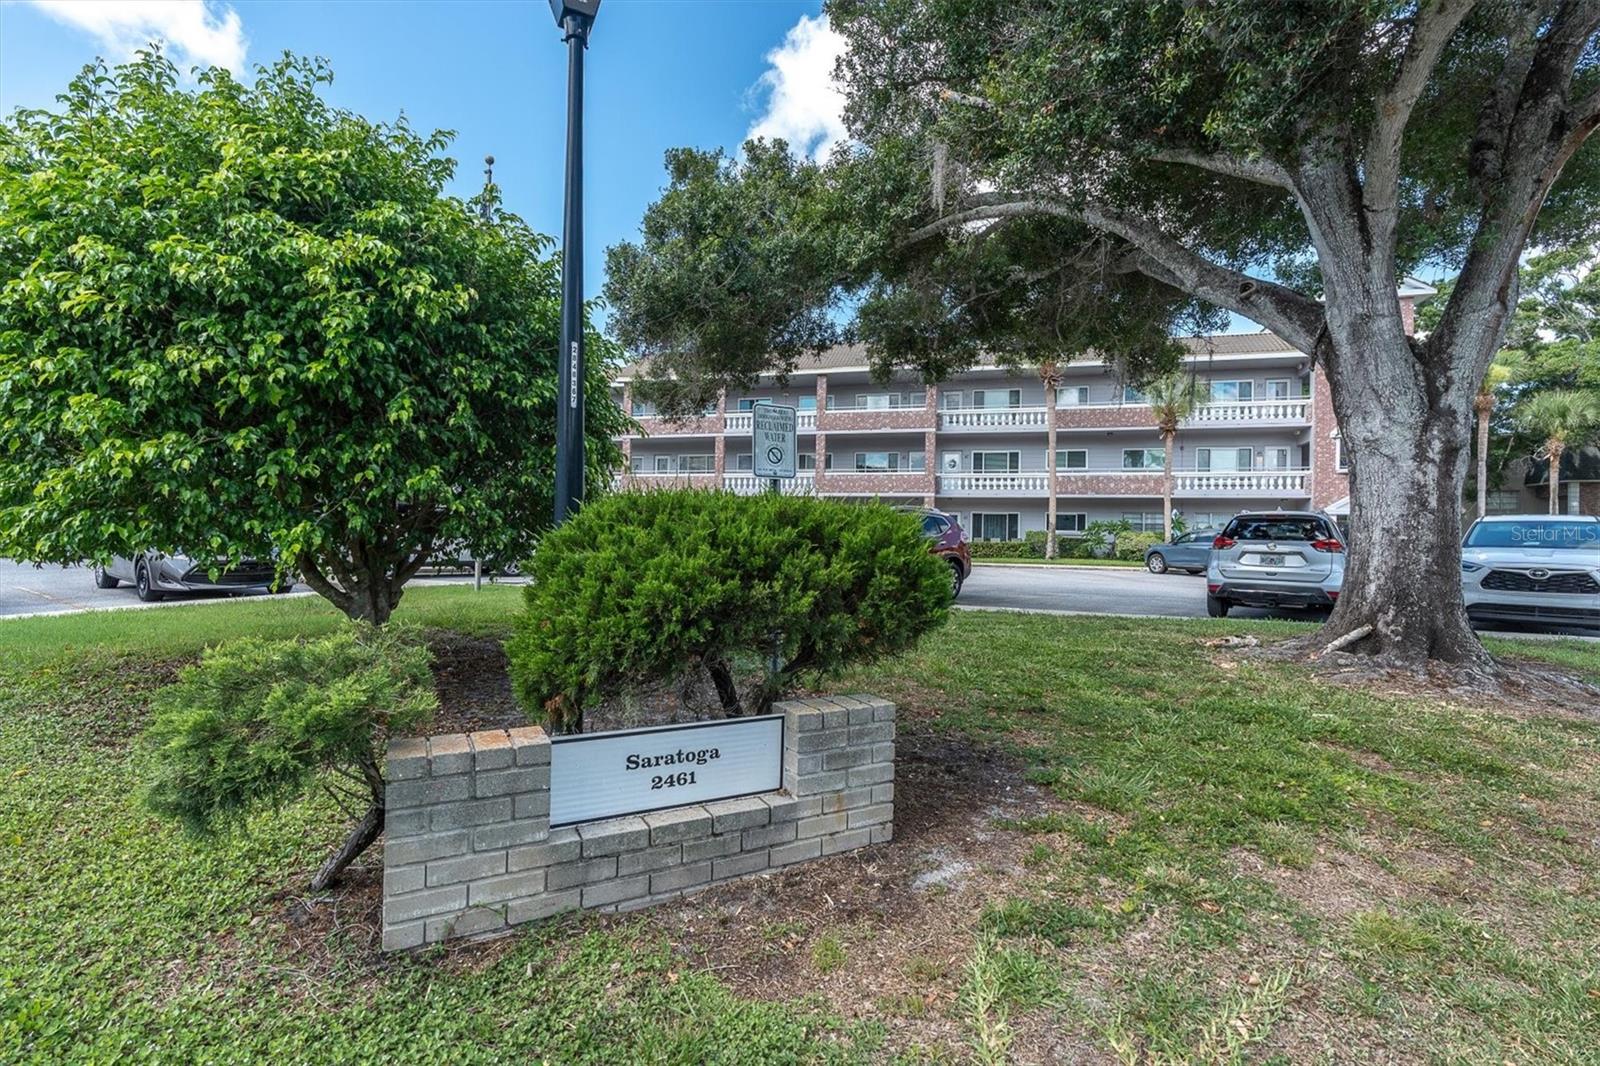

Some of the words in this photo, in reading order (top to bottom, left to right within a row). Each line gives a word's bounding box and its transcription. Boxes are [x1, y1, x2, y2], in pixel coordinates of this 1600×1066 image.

[756, 419, 794, 432] RECLAIMED
[764, 432, 786, 443] WATER
[625, 745, 721, 771] Saratoga
[651, 771, 697, 790] 2461
